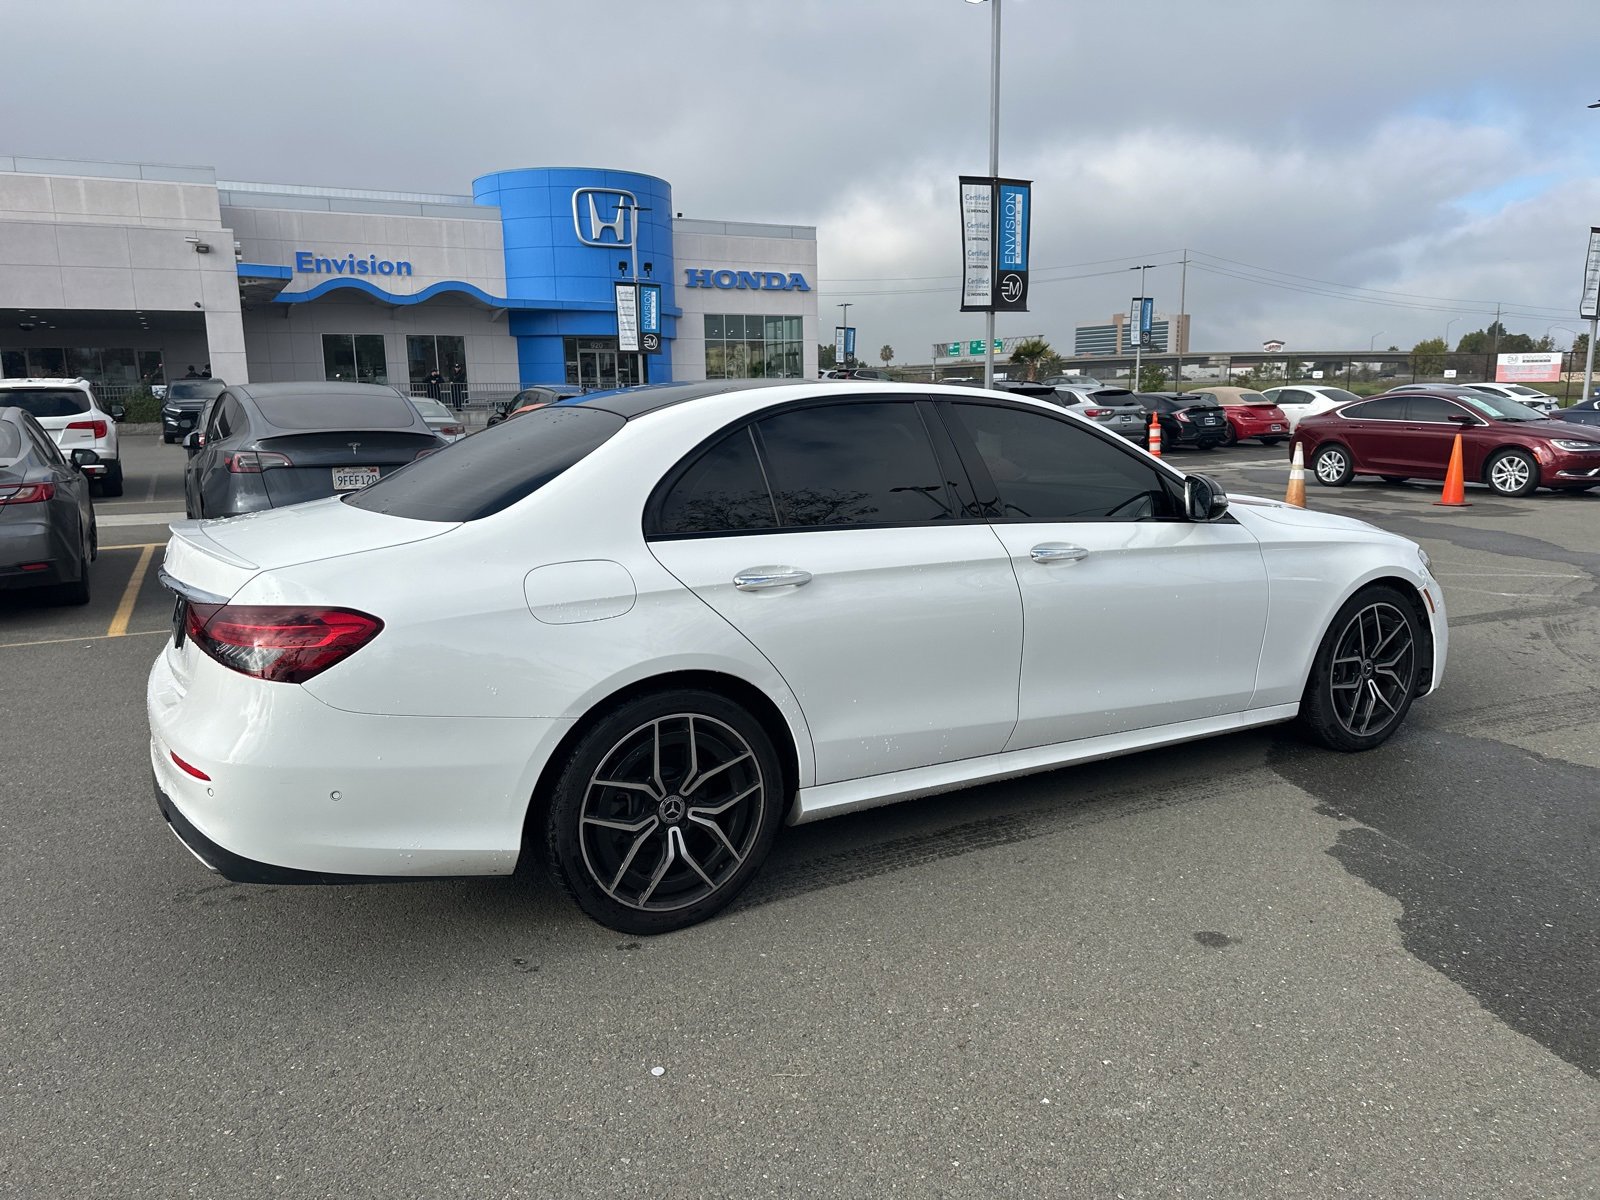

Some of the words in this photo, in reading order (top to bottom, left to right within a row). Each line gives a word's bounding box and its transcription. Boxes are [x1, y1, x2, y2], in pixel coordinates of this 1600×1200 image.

[1004, 192, 1016, 264] ENVISION
[295, 251, 412, 276] Envision
[685, 268, 811, 292] HONDA
[337, 474, 378, 486] 9FEF120
